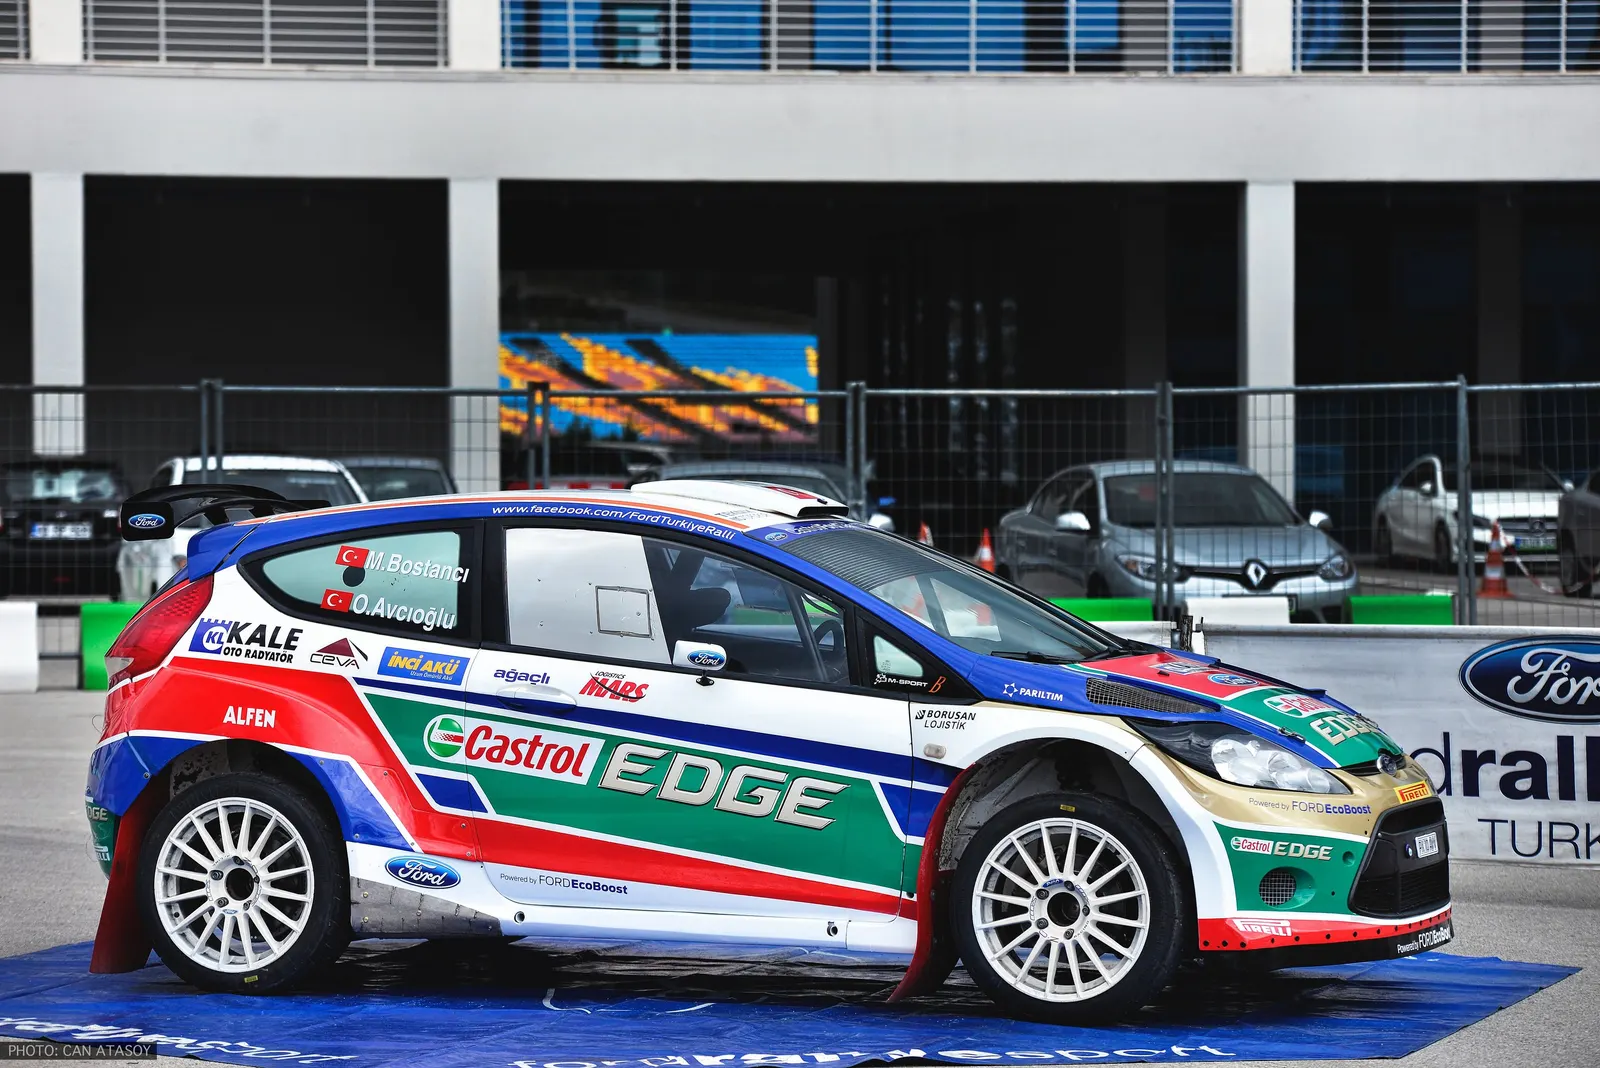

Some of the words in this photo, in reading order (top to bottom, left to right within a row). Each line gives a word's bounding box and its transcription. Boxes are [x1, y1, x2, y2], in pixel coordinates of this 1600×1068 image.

[491, 503, 737, 540] www.facebook.com/FordTurkiyeRalli
[205, 631, 225, 645] KL
[226, 620, 303, 650] KALE
[223, 646, 242, 657] OTO
[244, 648, 294, 664] RADYATÖR
[420, 659, 461, 676] AKÜ
[594, 670, 627, 680] LOGISTICS
[579, 676, 650, 703] MARS
[1019, 687, 1064, 702] PARILTIM
[223, 705, 277, 728] ALFEN
[926, 709, 977, 721] BORUSAN
[464, 724, 590, 778] Castrol
[597, 742, 851, 831] EDGE
[1398, 783, 1429, 802] PIRELLI
[1248, 797, 1280, 809] Powered
[1280, 802, 1290, 811] by
[1240, 837, 1271, 852] Castrol
[1272, 841, 1334, 861] EDGE
[398, 859, 449, 888] Ford
[500, 873, 528, 883] Powered
[529, 876, 538, 885] by
[1233, 918, 1292, 937] PIRELLI
